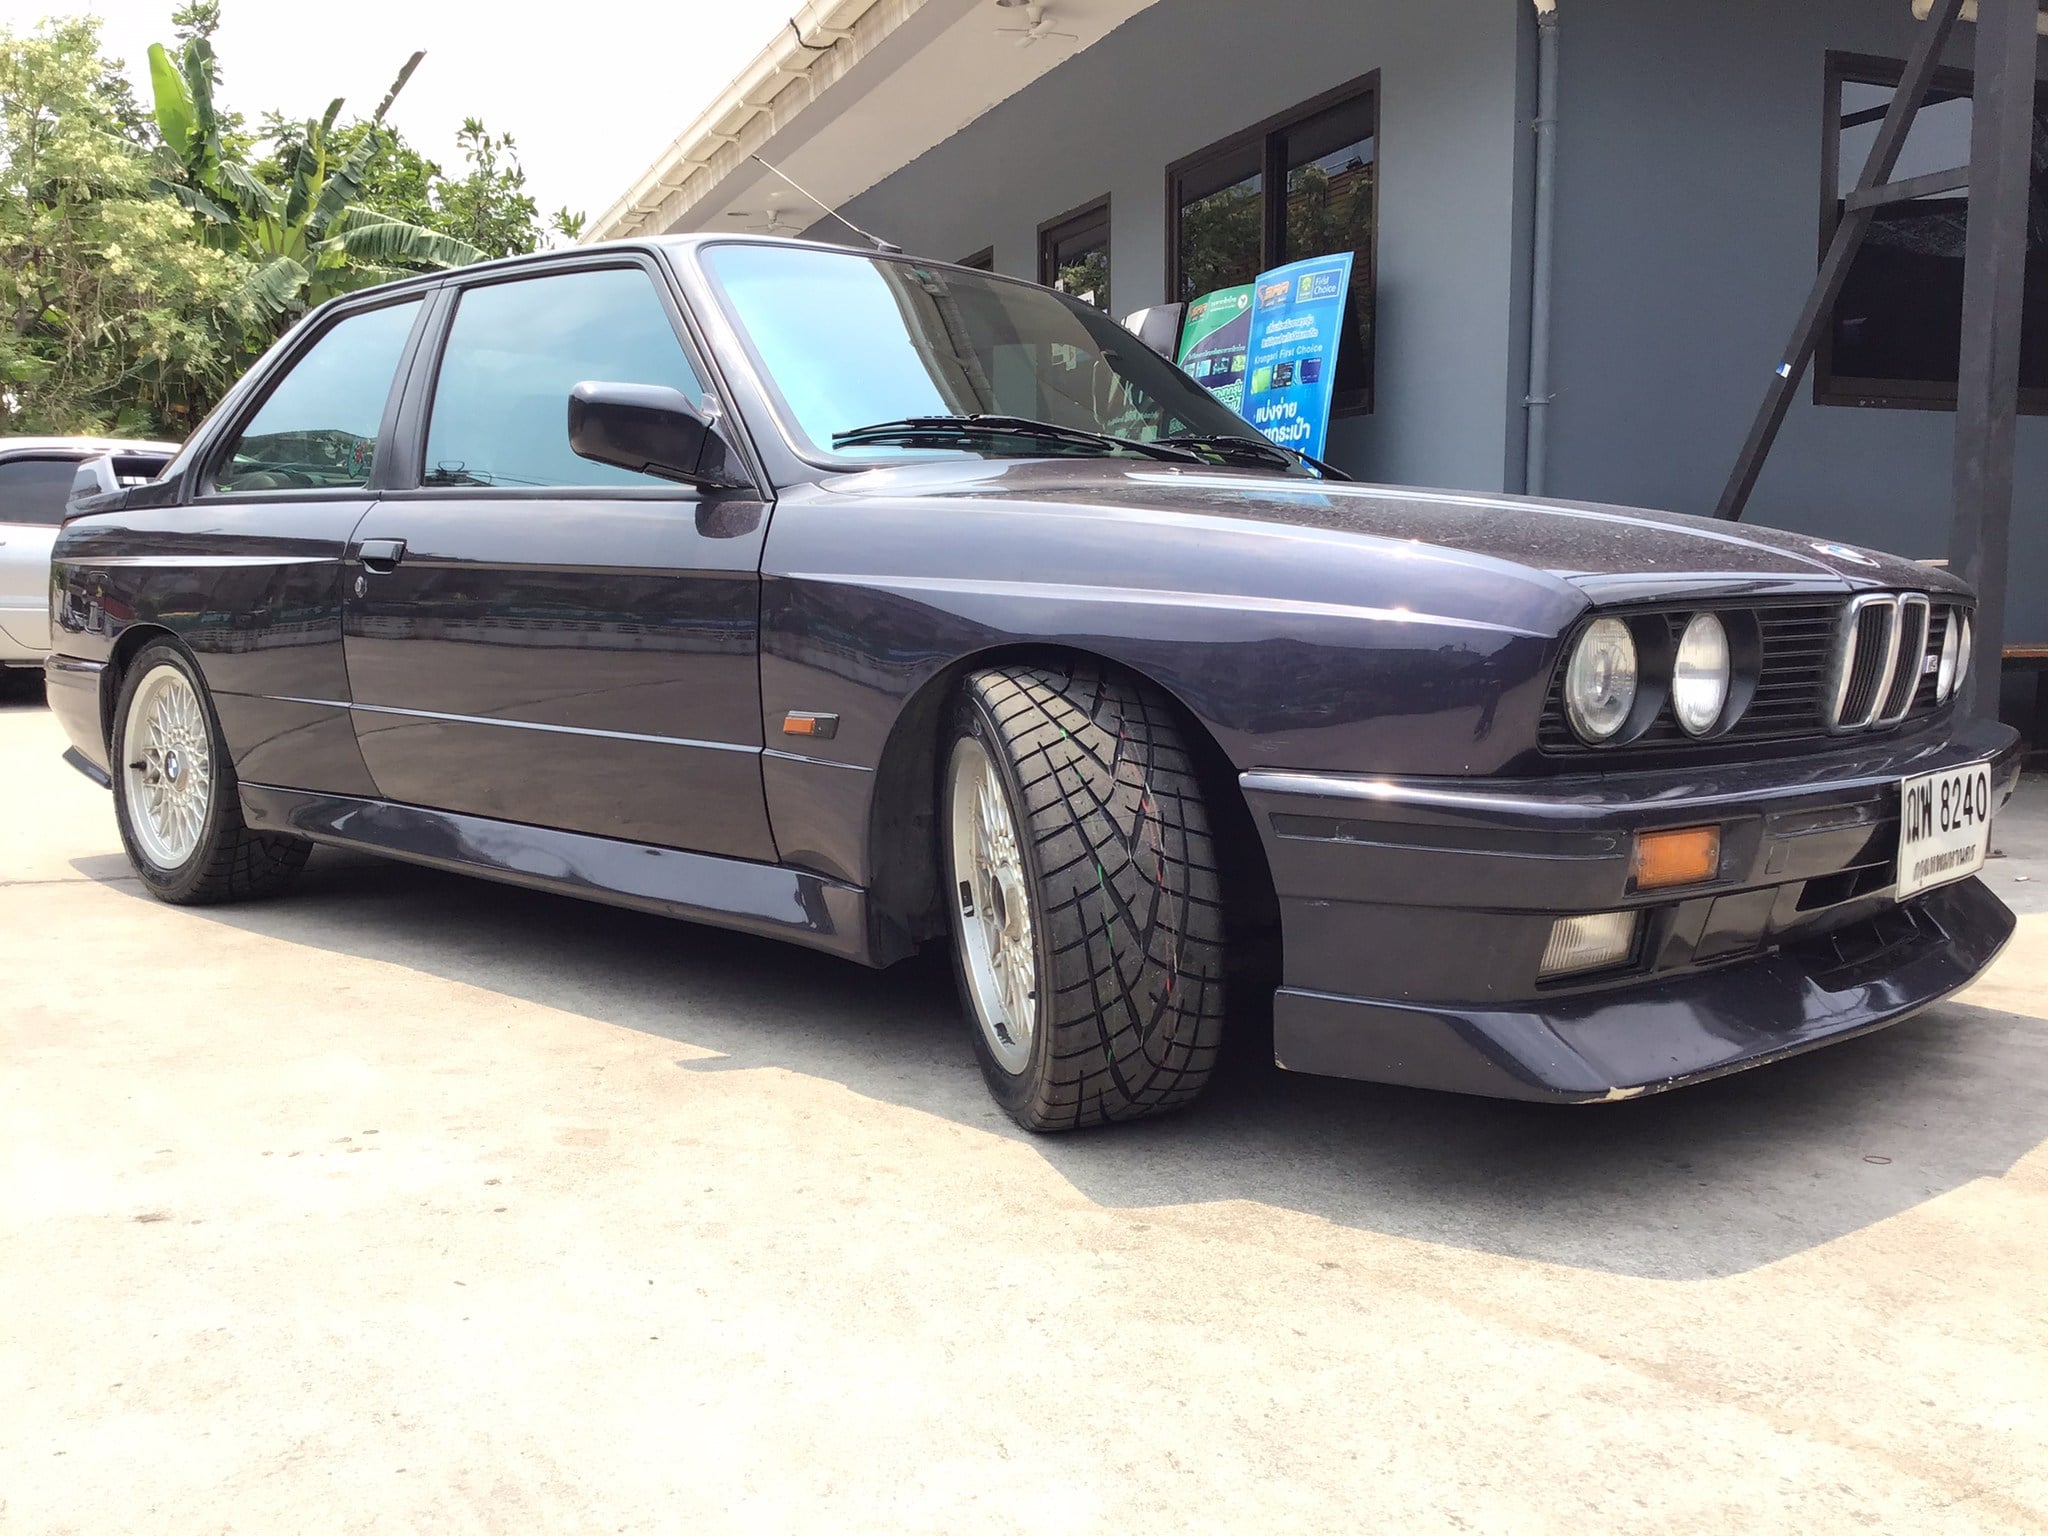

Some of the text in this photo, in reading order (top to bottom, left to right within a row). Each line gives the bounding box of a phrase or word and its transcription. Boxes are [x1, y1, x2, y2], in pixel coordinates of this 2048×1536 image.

[1315, 276, 1329, 286] First
[1314, 284, 1336, 295] Choice
[1279, 348, 1295, 359] First
[1296, 344, 1323, 354] Choice
[1256, 396, 1297, 424] แบ่งจ่าย
[1940, 771, 1987, 833] 8240
